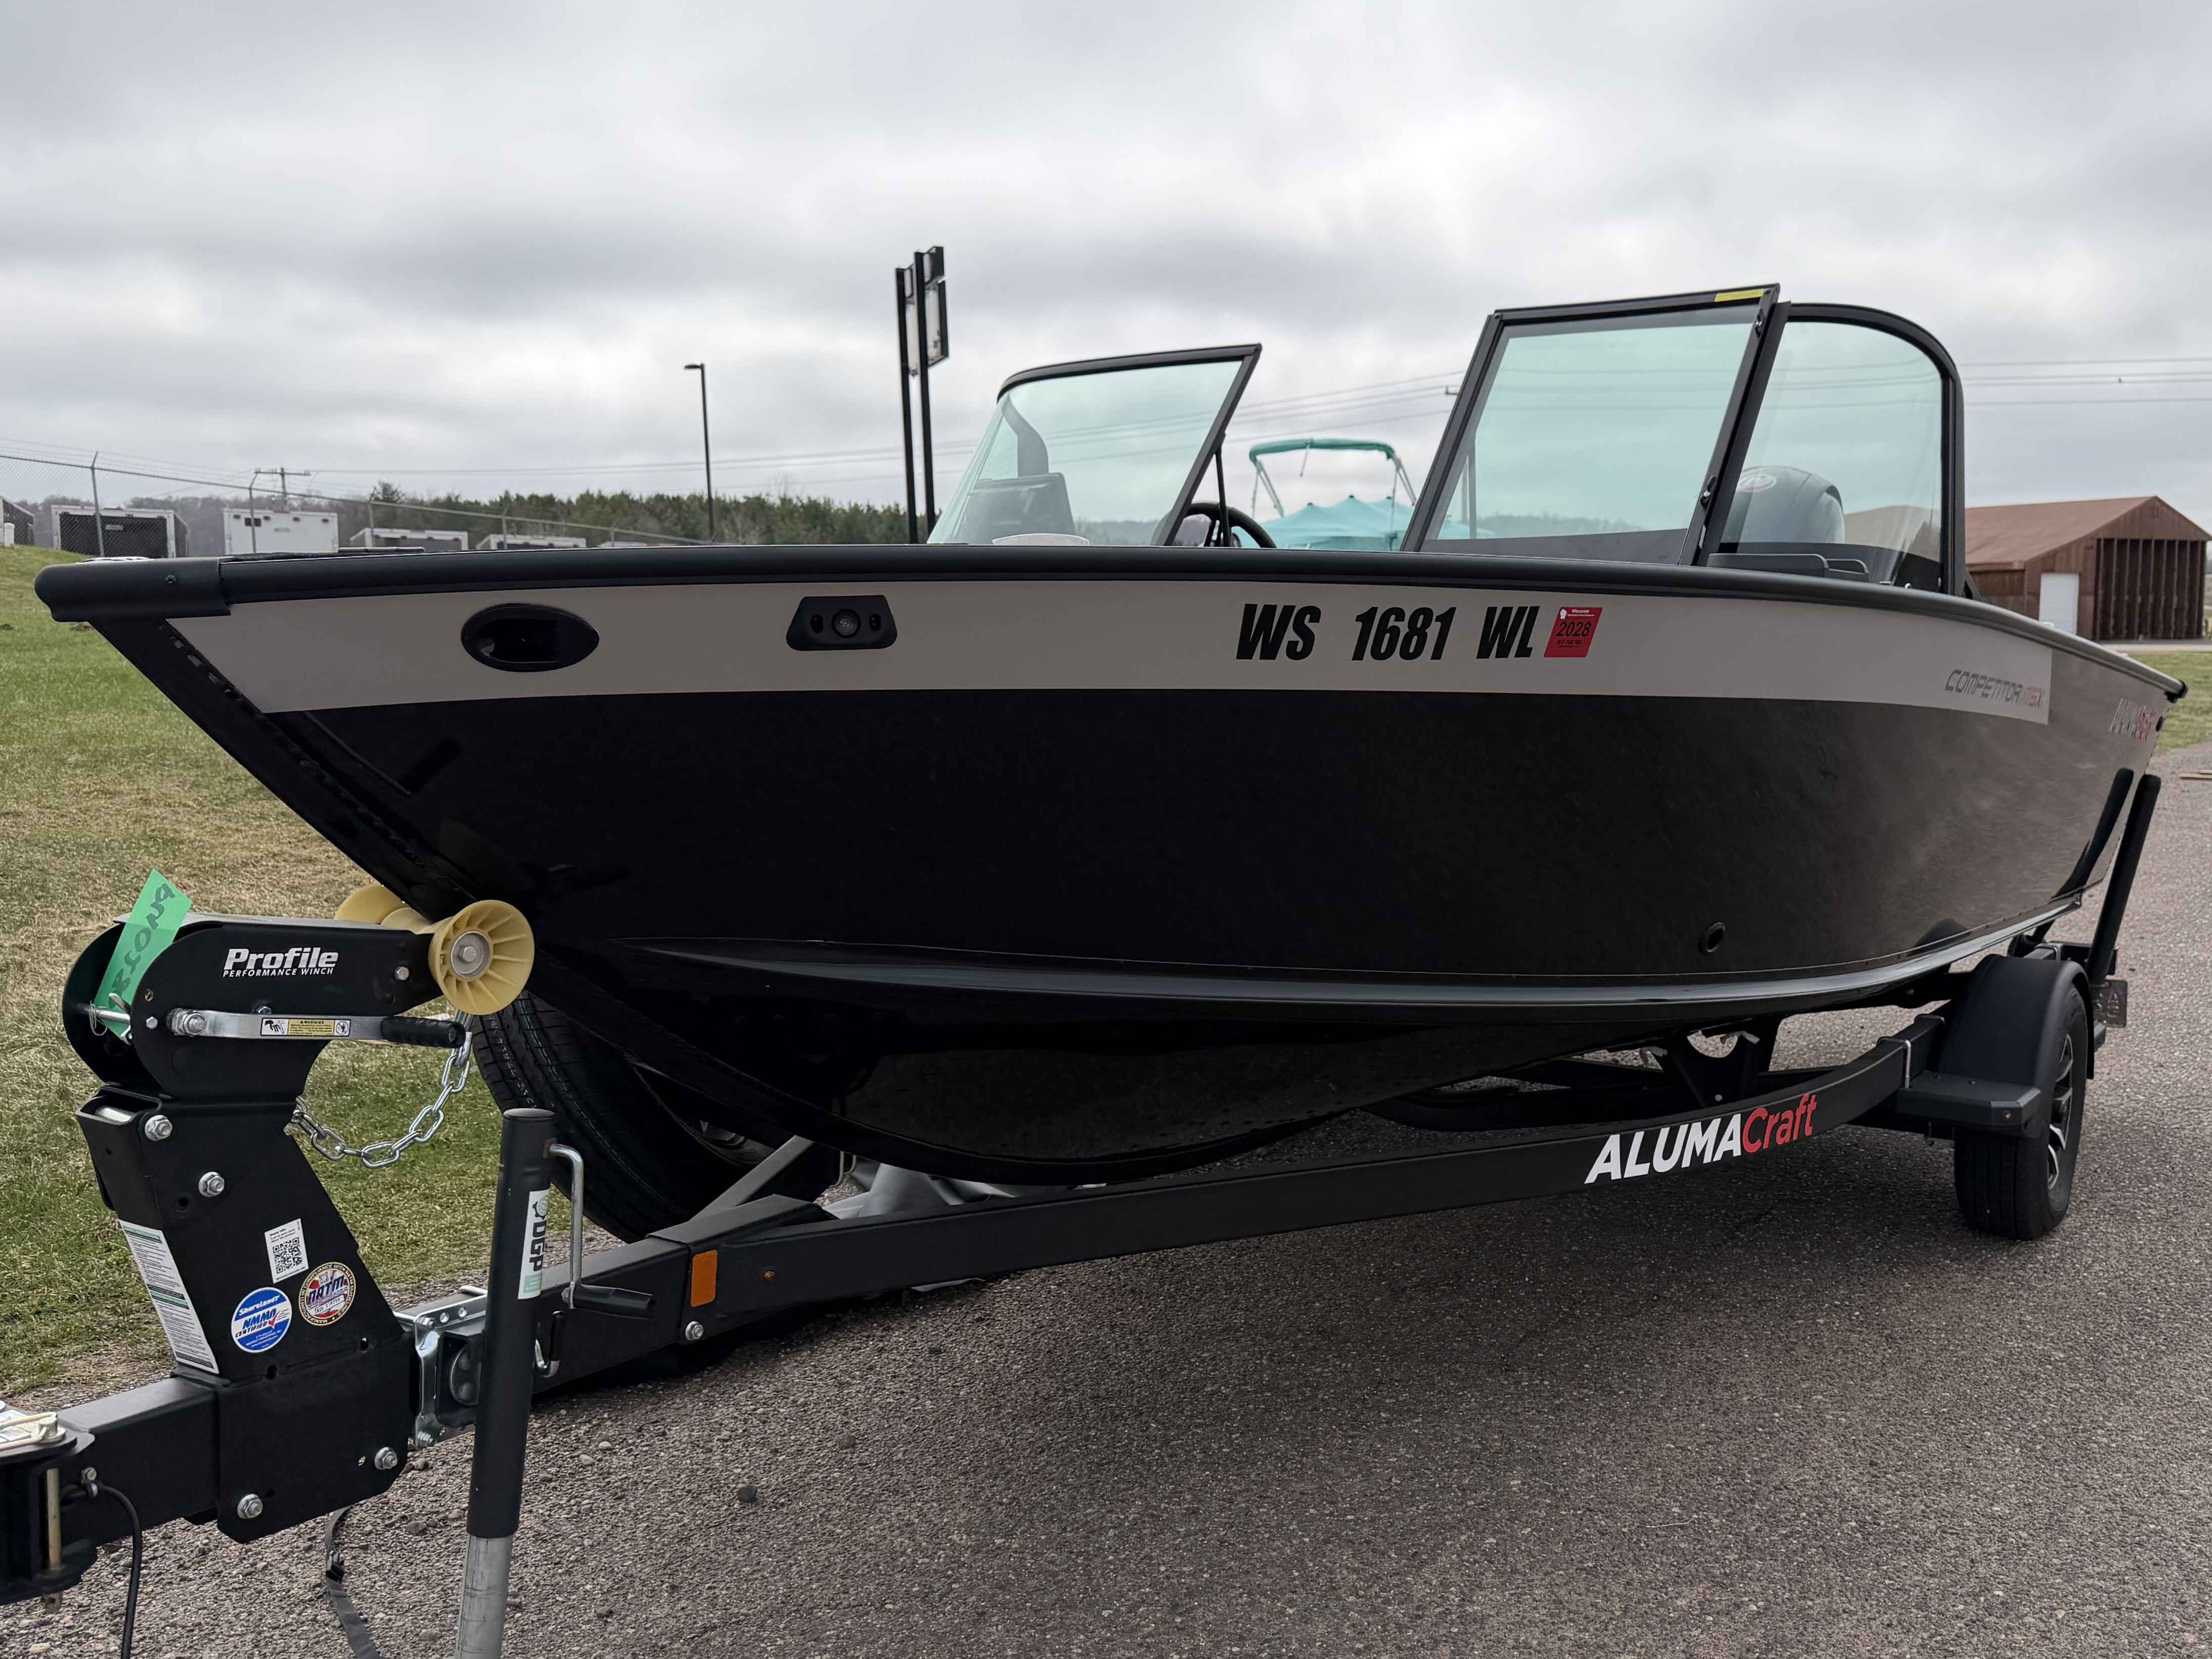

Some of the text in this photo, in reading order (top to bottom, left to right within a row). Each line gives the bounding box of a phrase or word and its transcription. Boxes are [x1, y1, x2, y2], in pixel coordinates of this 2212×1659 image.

[1236, 604, 1540, 661] WS 1681 WL
[1556, 621, 1592, 637] 2028
[1945, 669, 2023, 703] COMPETITOR
[223, 967, 334, 978] PERFORMANCE WINCH
[224, 947, 338, 970] Profile
[1584, 1094, 1817, 1184] ALUMACraft
[529, 1220, 547, 1272] DGP
[235, 1321, 268, 1338] CERTIFIED
